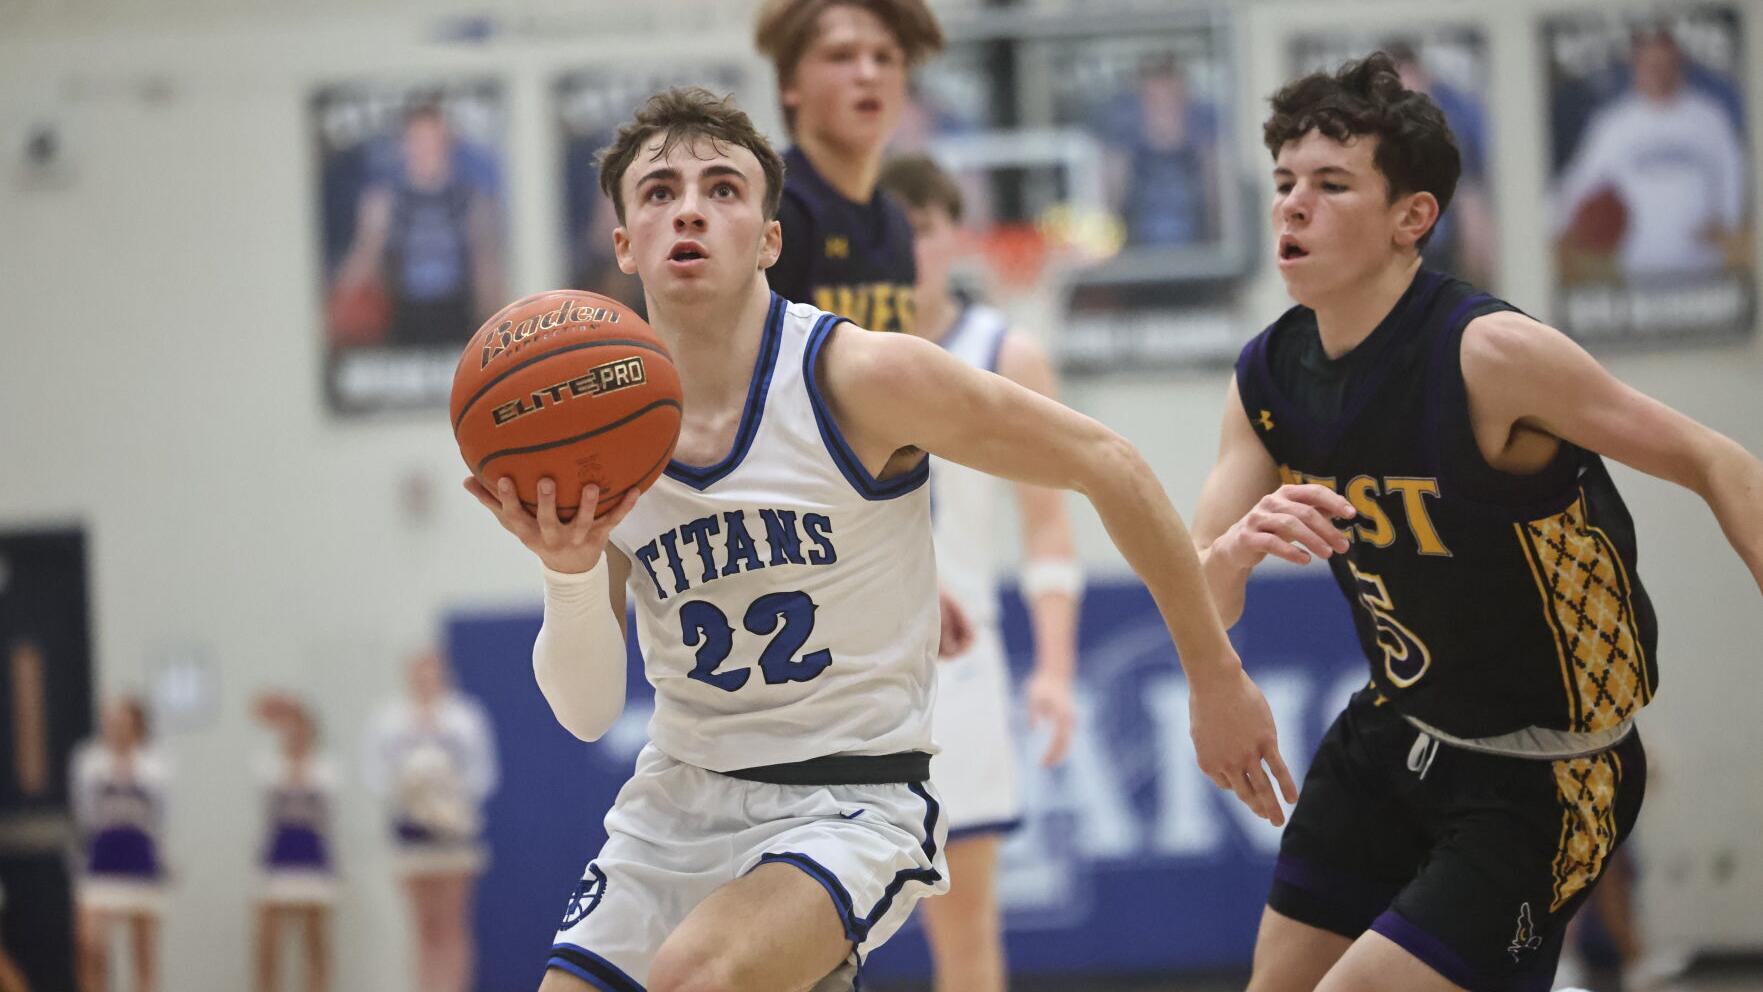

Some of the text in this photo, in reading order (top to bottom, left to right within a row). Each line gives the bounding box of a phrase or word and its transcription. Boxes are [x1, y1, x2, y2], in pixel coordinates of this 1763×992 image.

[480, 299, 621, 371] Baden
[491, 371, 600, 427] ELITE
[598, 355, 646, 393] PRO
[635, 508, 837, 600] TITANS
[679, 590, 833, 692] 22
[1347, 559, 1431, 689] 5
